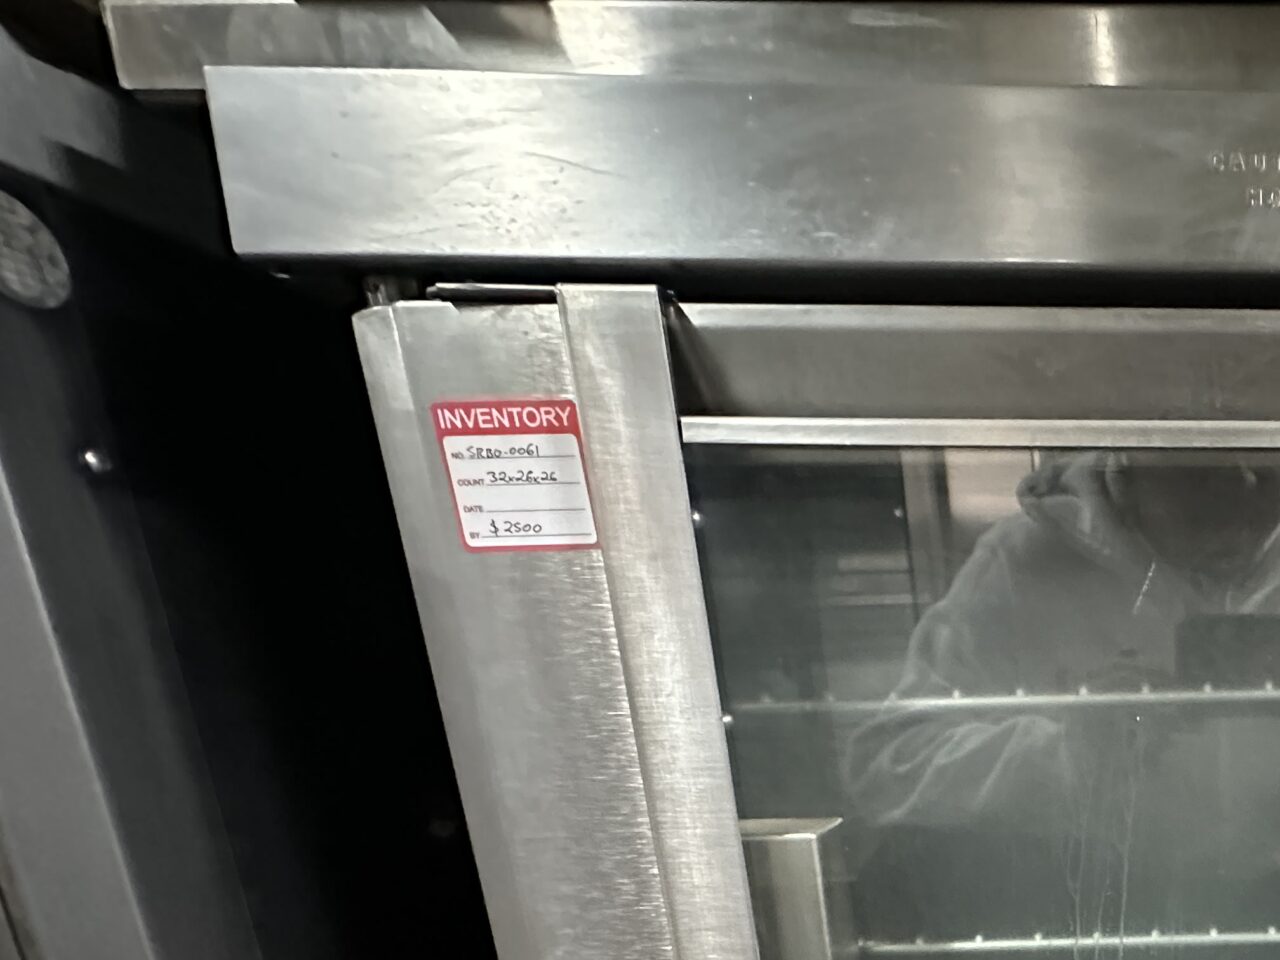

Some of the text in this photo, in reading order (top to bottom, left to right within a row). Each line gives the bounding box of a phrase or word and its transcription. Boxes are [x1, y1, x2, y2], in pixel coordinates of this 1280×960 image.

[437, 406, 571, 429] INVENTORY
[457, 479, 484, 487] COUNT
[463, 505, 484, 513] DATE
[504, 521, 542, 534] 2500
